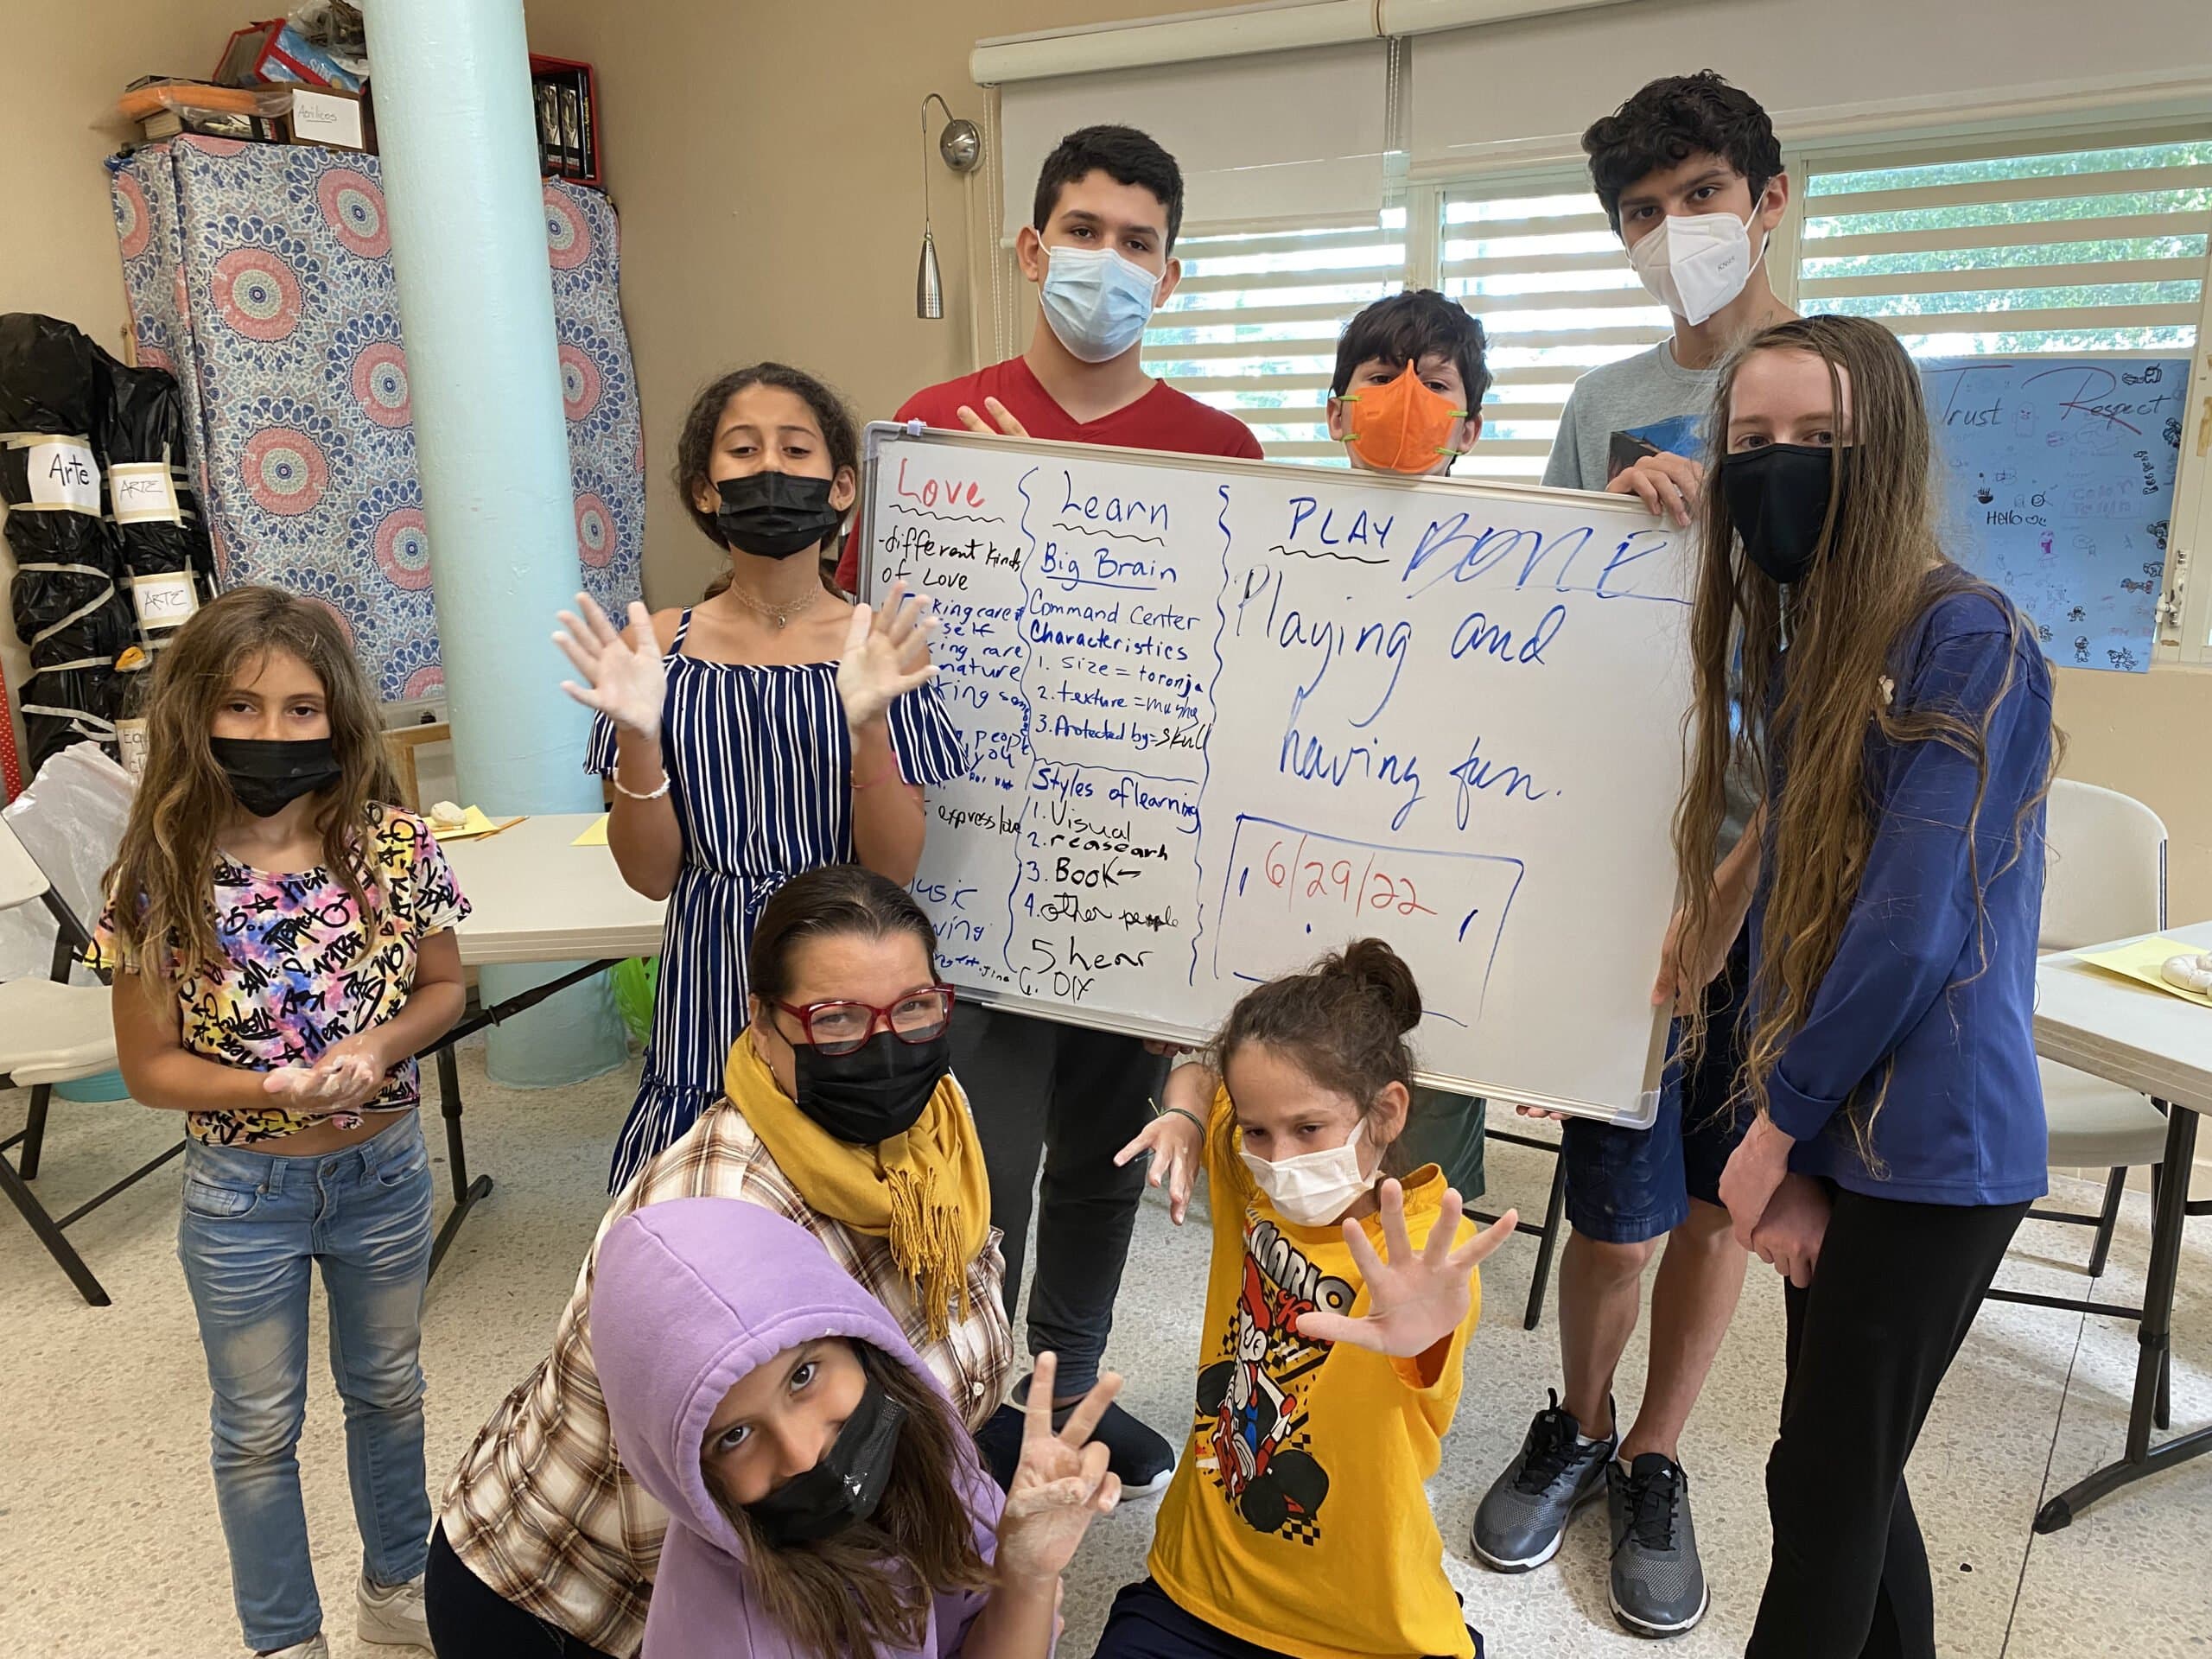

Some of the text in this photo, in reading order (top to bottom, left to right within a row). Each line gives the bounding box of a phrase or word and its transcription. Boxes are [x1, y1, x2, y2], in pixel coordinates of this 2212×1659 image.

[1920, 365, 2171, 435] Trust Respect
[49, 452, 90, 486] Arte
[119, 480, 163, 499] ARTE
[898, 457, 987, 508] Love
[1061, 469, 1170, 531] Learn
[1288, 496, 1395, 549] PLAY
[882, 558, 969, 591] of Love
[1040, 542, 1179, 591] Big Brain
[143, 589, 188, 615] ARTE
[1029, 588, 1202, 631] Command Center
[1030, 619, 1190, 660] Characteristics
[1234, 563, 1567, 728] Playing and
[1280, 686, 1427, 831] having
[1033, 767, 1094, 803] Styles
[1109, 777, 1135, 810] of
[1052, 800, 1131, 842] Visual
[1265, 834, 1439, 918] 6/29/22
[1249, 1220, 1358, 1315] MARIO
